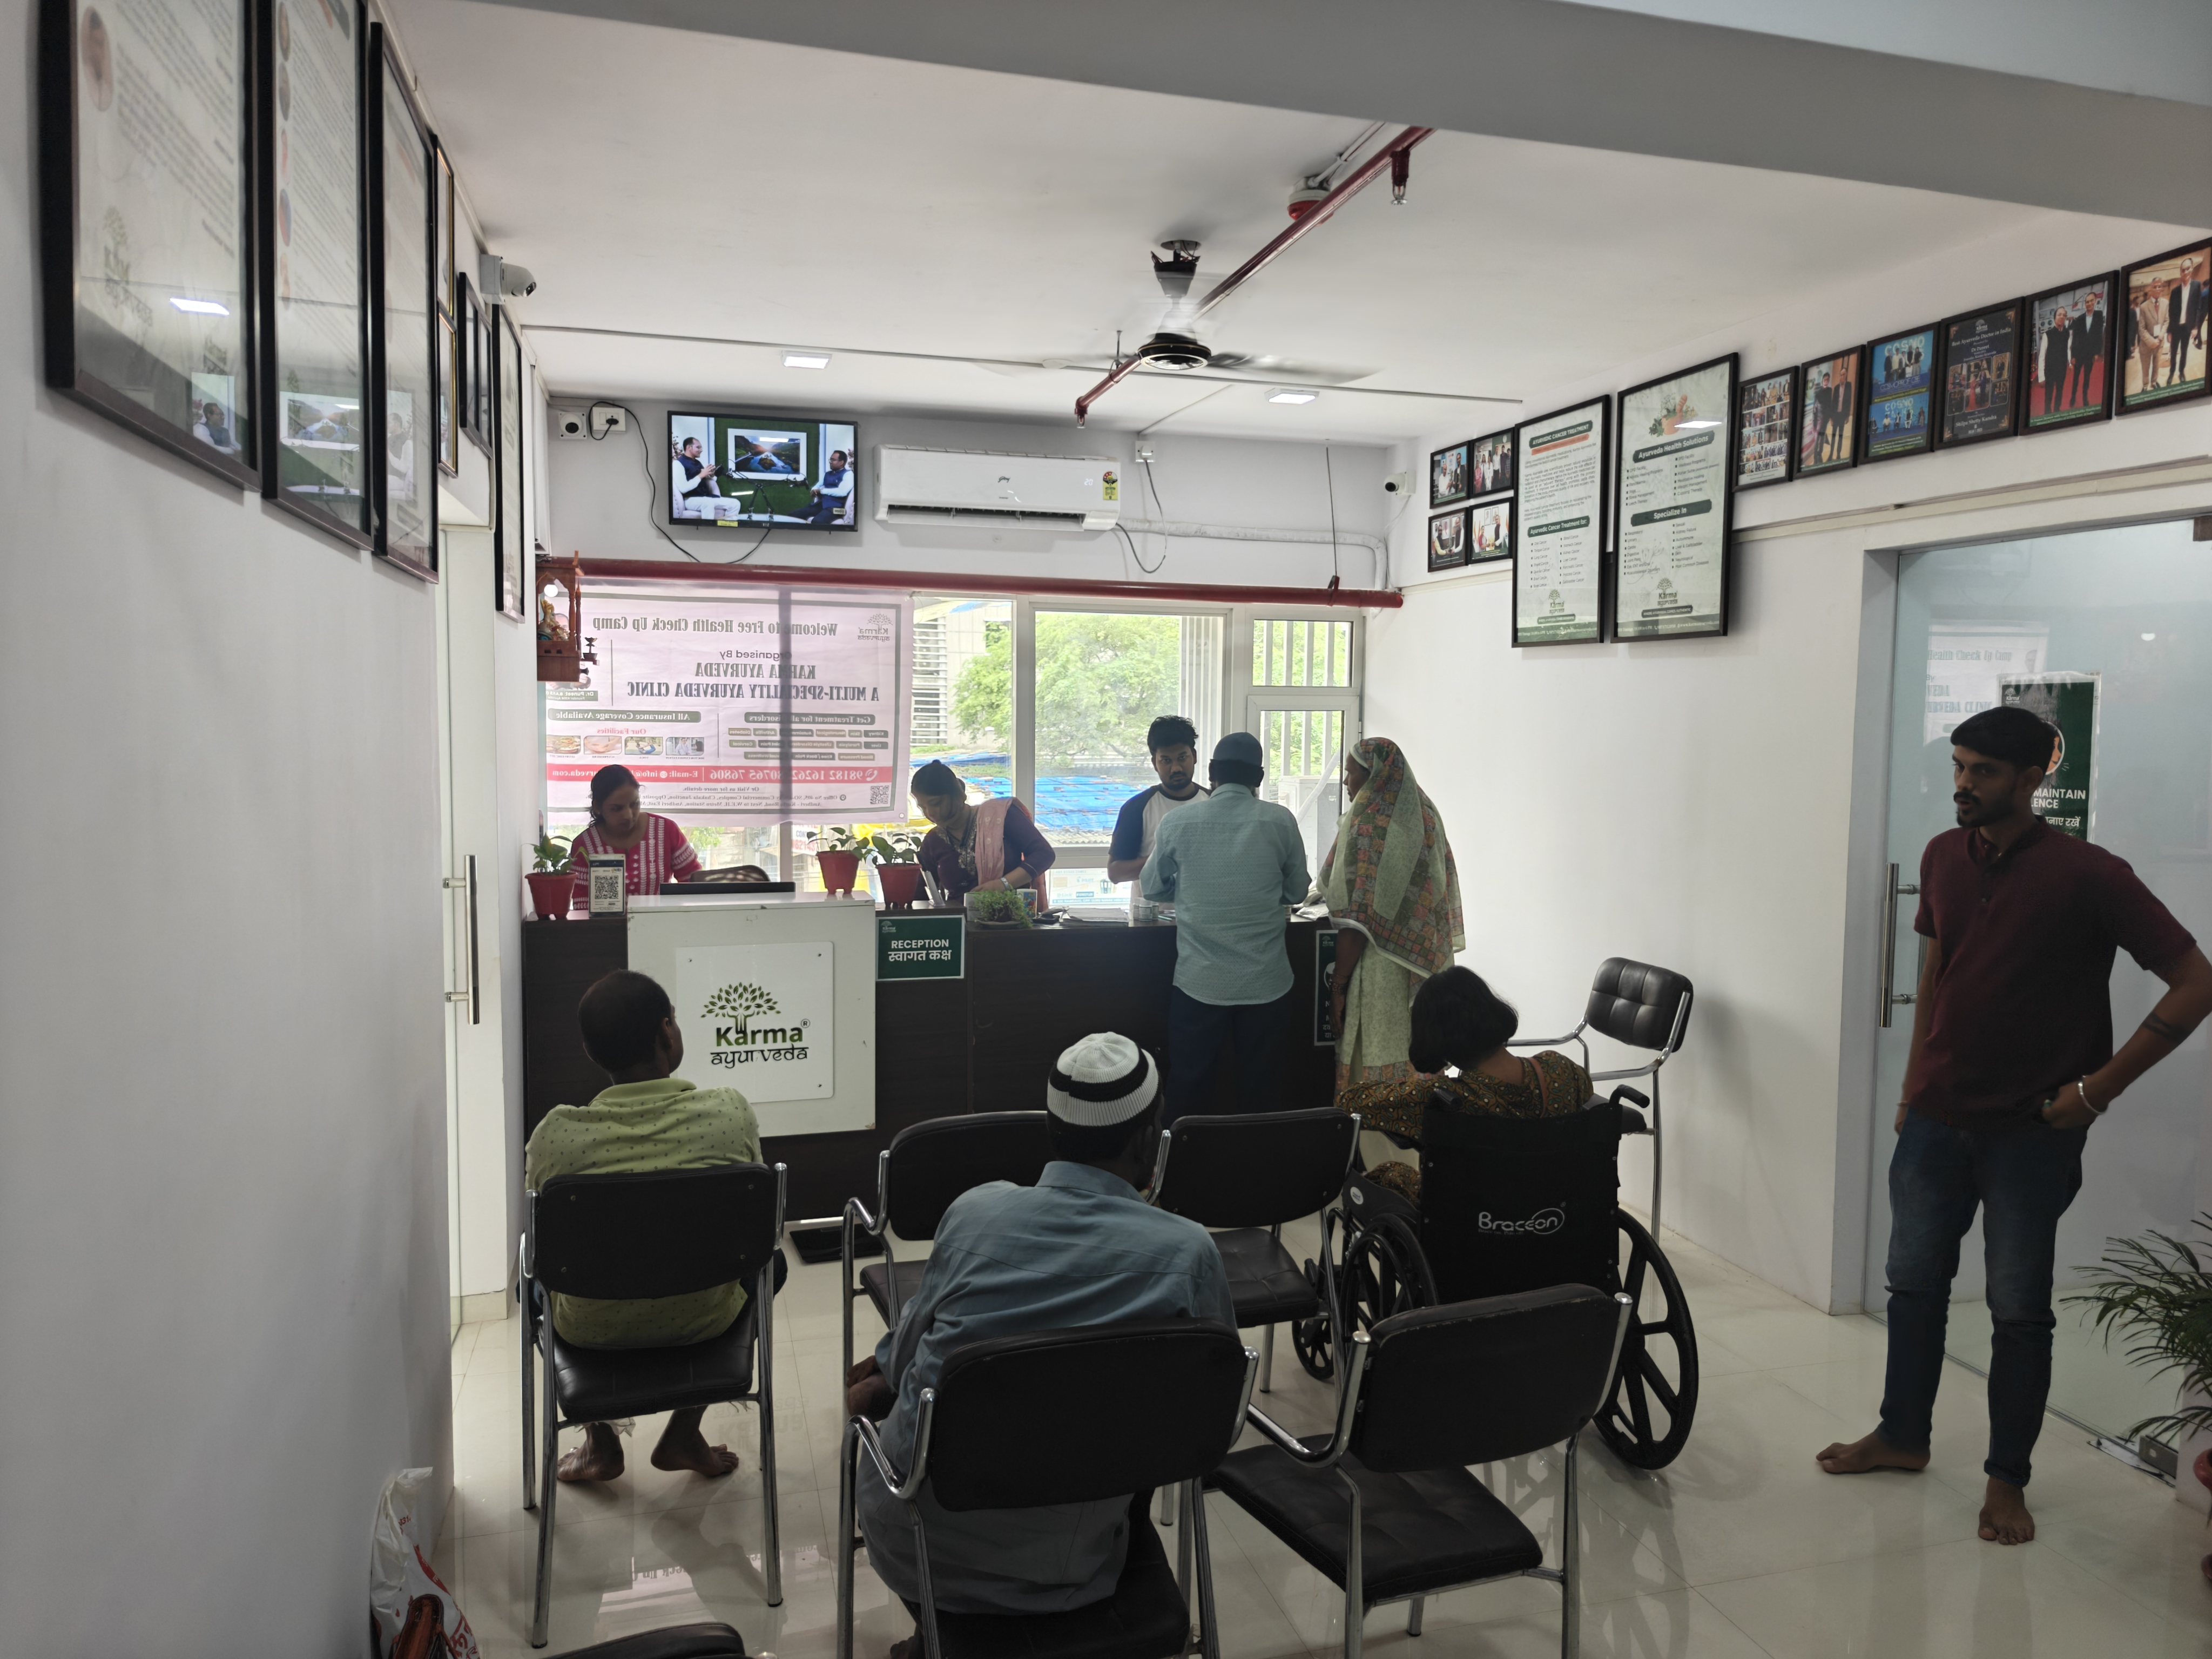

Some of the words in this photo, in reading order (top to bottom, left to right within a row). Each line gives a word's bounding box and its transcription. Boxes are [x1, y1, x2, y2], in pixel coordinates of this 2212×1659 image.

[1961, 335, 1980, 345] Ayurveda
[1533, 434, 1552, 445] AYURVEDIC
[1552, 431, 1567, 439] CANCER
[1567, 424, 1589, 434] TREATMENT
[1638, 448, 1663, 458] Ayurveda
[1664, 443, 1682, 451] Health
[1683, 435, 1709, 446] Solutions
[1654, 509, 1680, 520] Specialize
[1530, 526, 1548, 535] Ayurvedic
[1561, 521, 1580, 529] Treatment
[2034, 788, 2086, 799] MAINTAIN
[2065, 816, 2081, 827] रखें
[891, 939, 949, 949] RECEPTION
[888, 950, 927, 962] स्वागत
[928, 949, 952, 961] कक्ष
[716, 1026, 803, 1047] Karma
[710, 1043, 809, 1069] ayurveda
[1478, 1211, 1559, 1231] Braceon
